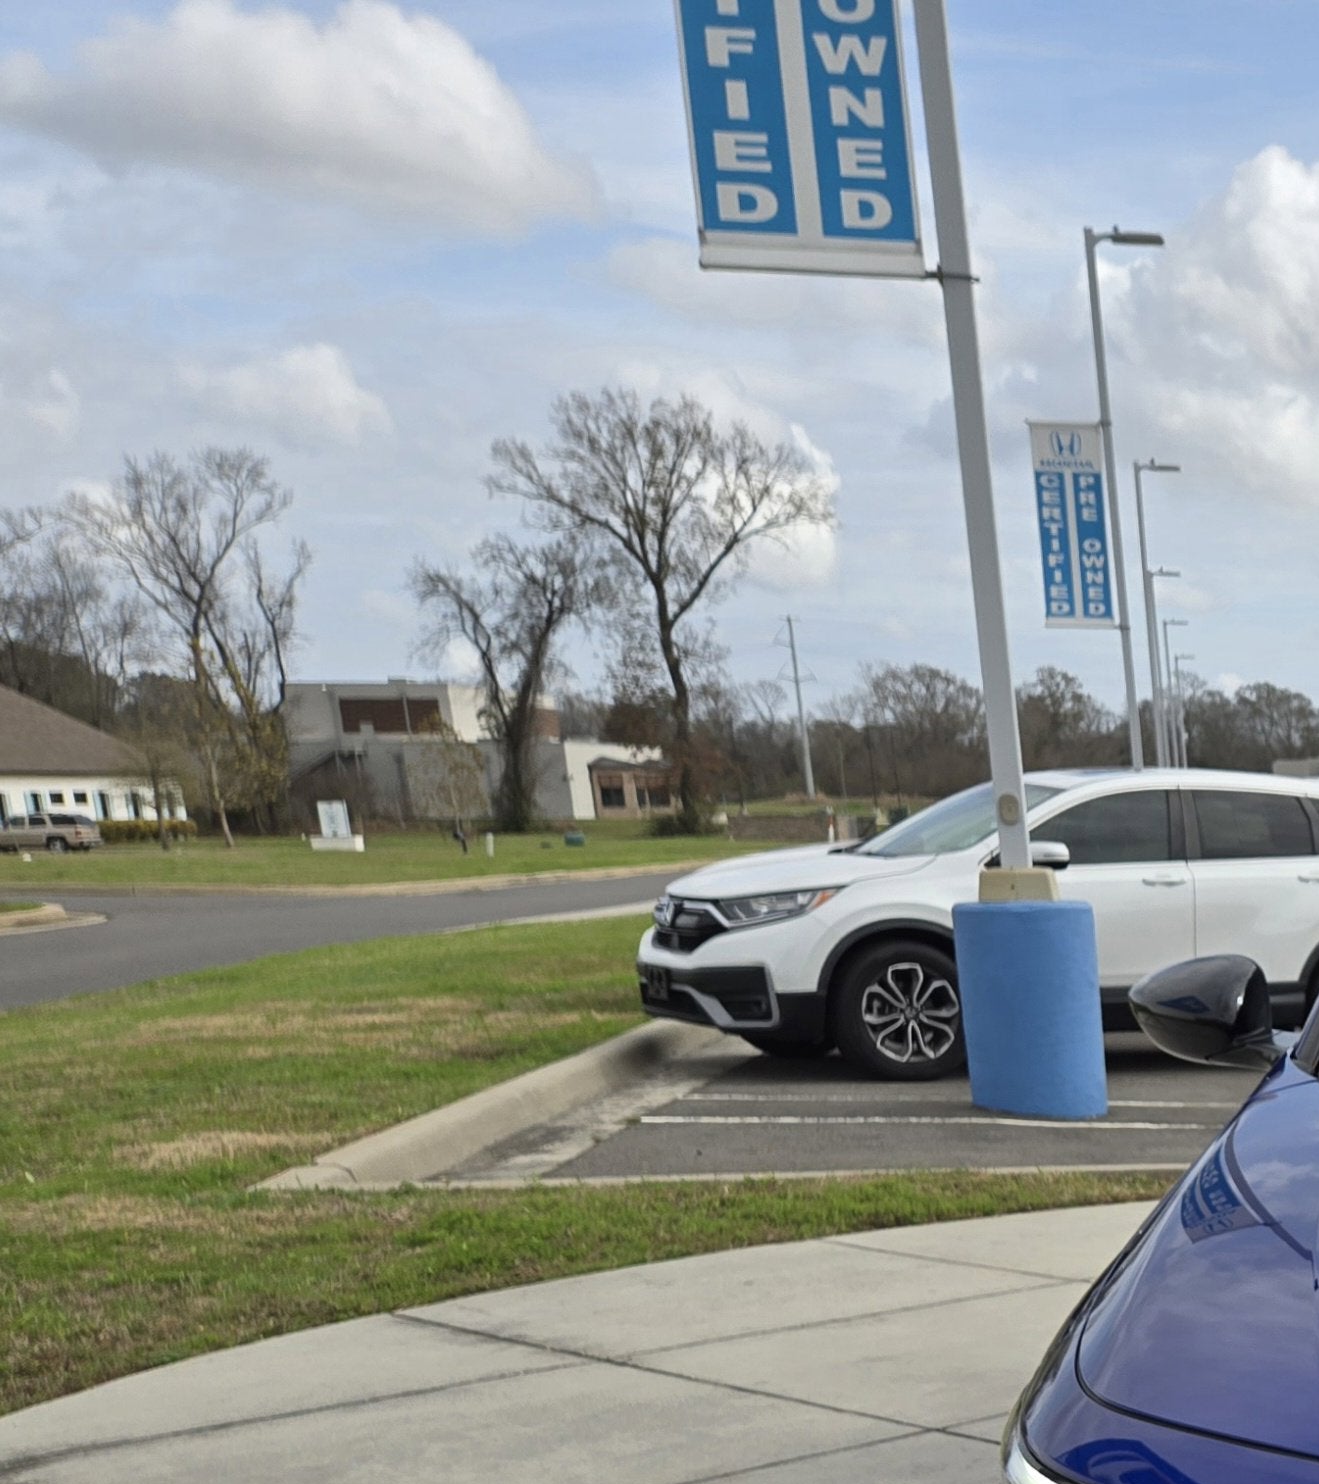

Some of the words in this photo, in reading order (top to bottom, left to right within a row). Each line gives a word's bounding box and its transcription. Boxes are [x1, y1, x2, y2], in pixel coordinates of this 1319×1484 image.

[812, 0, 893, 230] OWNED
[1039, 474, 1071, 616] CERTIFIED
[1079, 475, 1098, 522] PRE
[1082, 538, 1106, 616] OWNED
